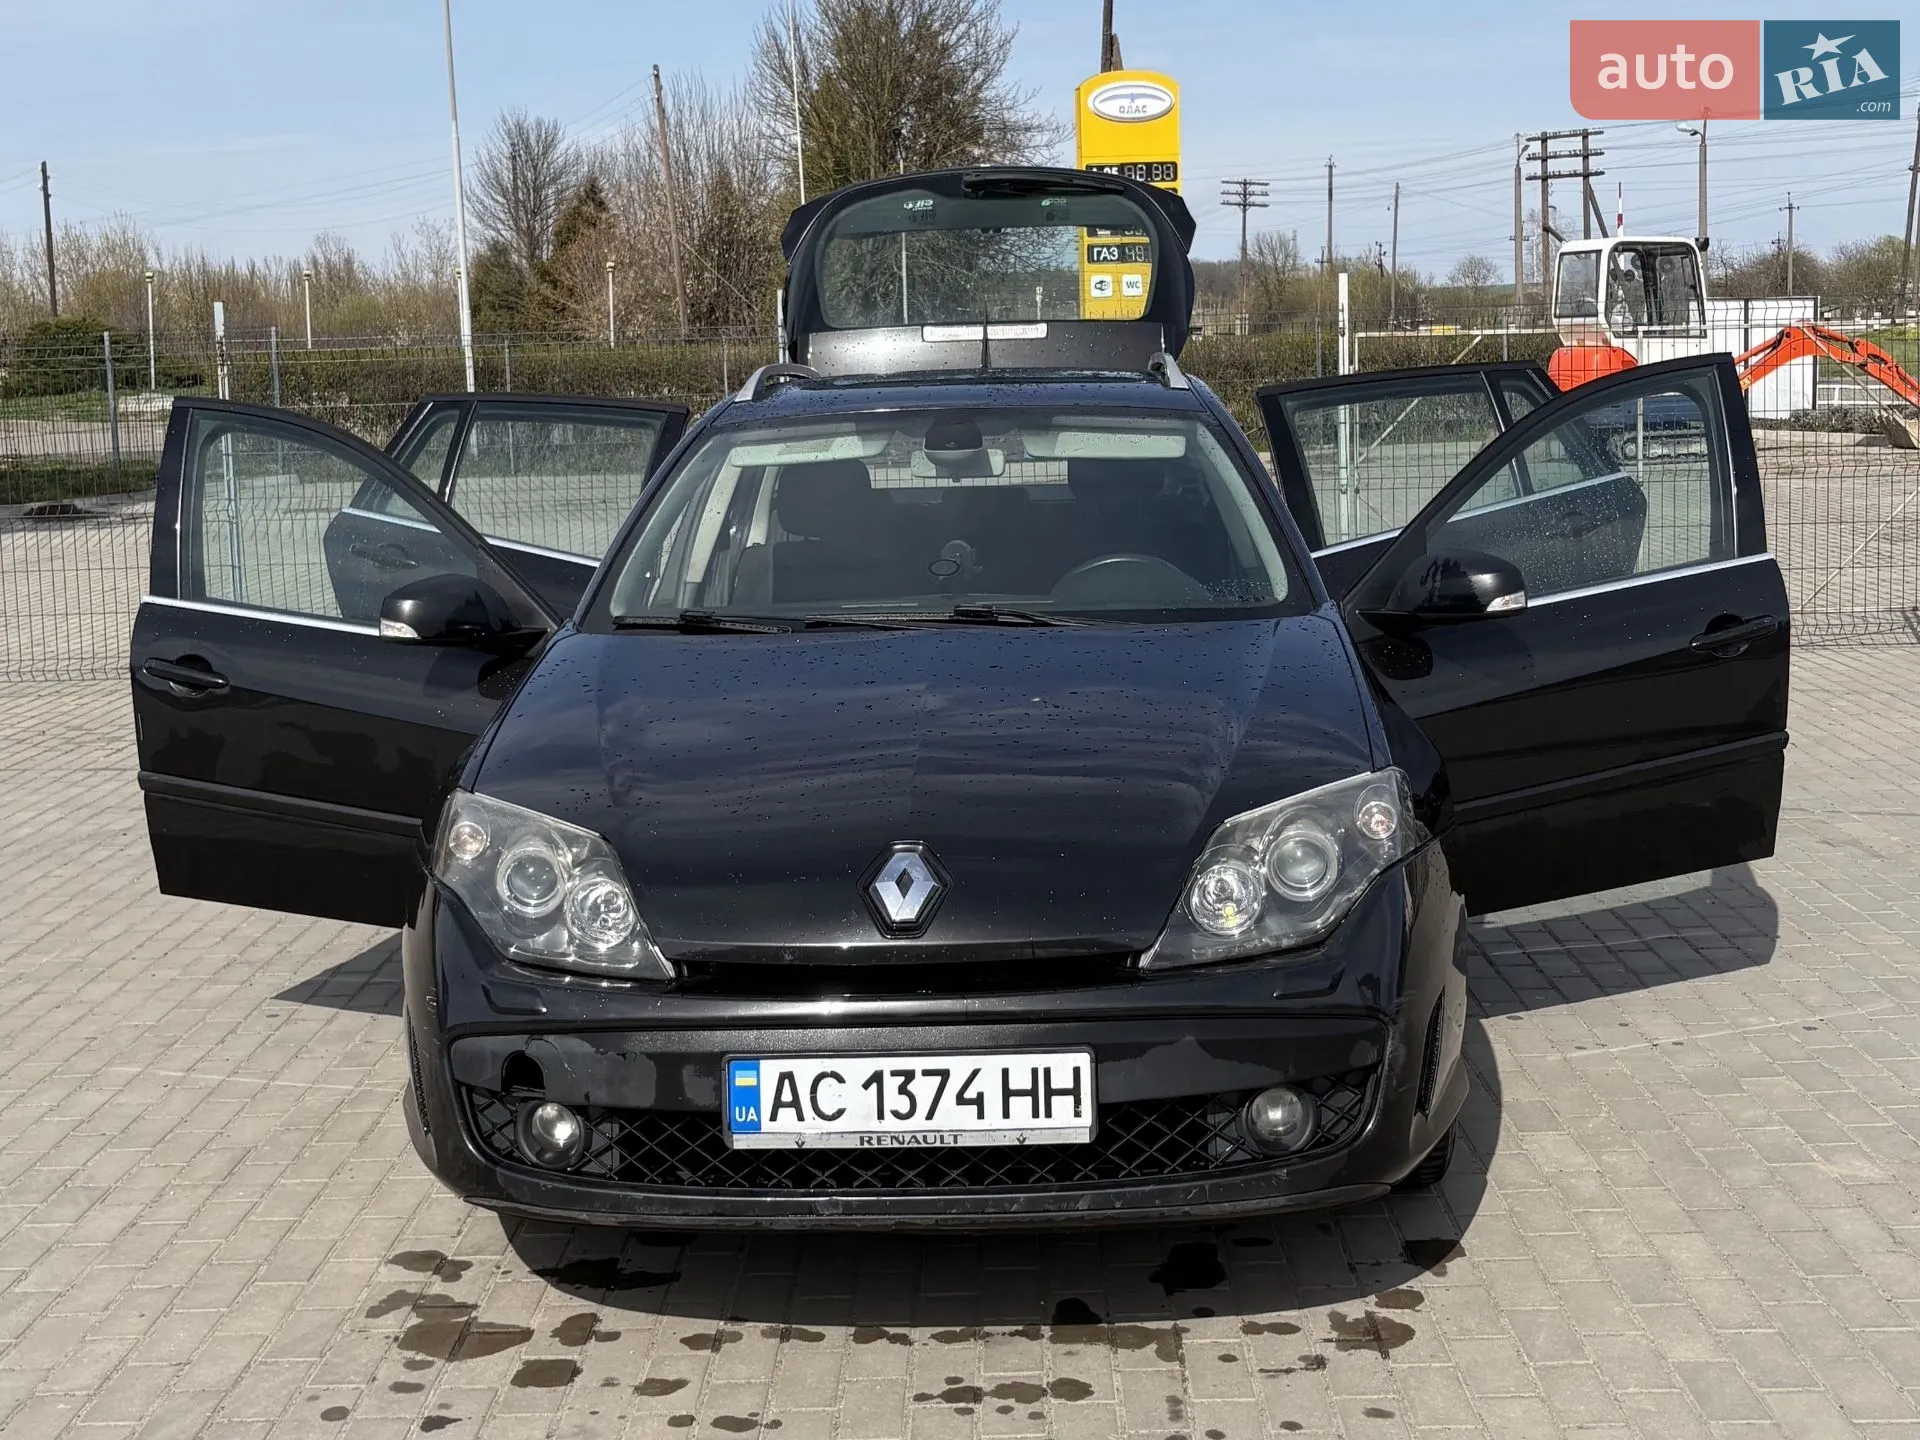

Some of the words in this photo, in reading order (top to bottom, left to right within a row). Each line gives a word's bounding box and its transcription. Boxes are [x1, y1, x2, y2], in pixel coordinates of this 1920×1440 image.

[1093, 247, 1119, 261] ГАЗ
[1126, 281, 1141, 289] WC
[769, 1070, 847, 1122] AC
[861, 1067, 985, 1121] 1374
[1001, 1065, 1083, 1119] HH
[735, 1106, 758, 1122] UA
[858, 1132, 964, 1147] RENAULT
